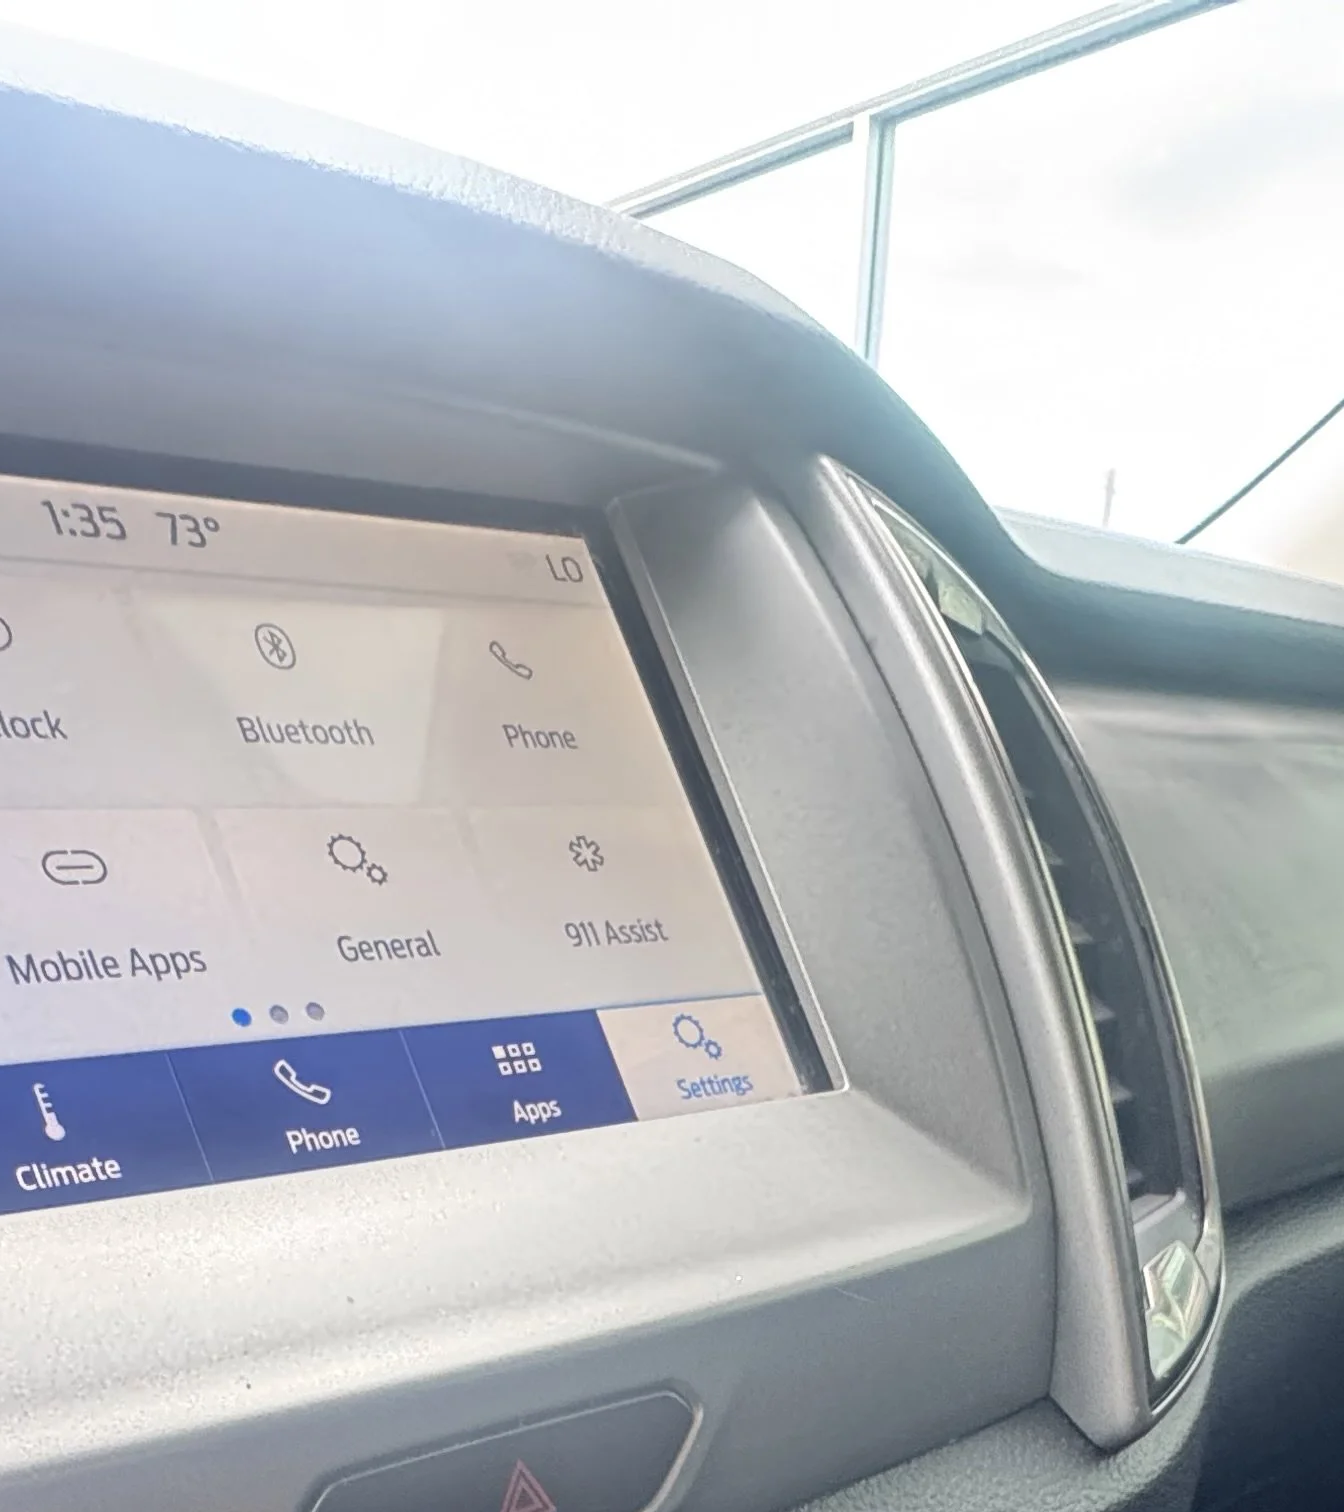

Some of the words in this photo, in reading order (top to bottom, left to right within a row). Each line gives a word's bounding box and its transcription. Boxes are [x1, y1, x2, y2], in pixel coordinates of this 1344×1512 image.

[41, 500, 129, 542] 1:35
[155, 511, 221, 549] 73°
[545, 553, 584, 584] LO
[237, 714, 375, 749] Bluetooth
[502, 722, 579, 752] Phone
[336, 929, 442, 964] General
[565, 922, 600, 948] 911
[604, 918, 670, 946] Assist
[5, 947, 121, 986] Mobile
[129, 945, 208, 984] Apps
[675, 1071, 755, 1102] Settings
[512, 1096, 562, 1127] Apps
[285, 1123, 362, 1155] Phone
[15, 1154, 123, 1193] Climate
